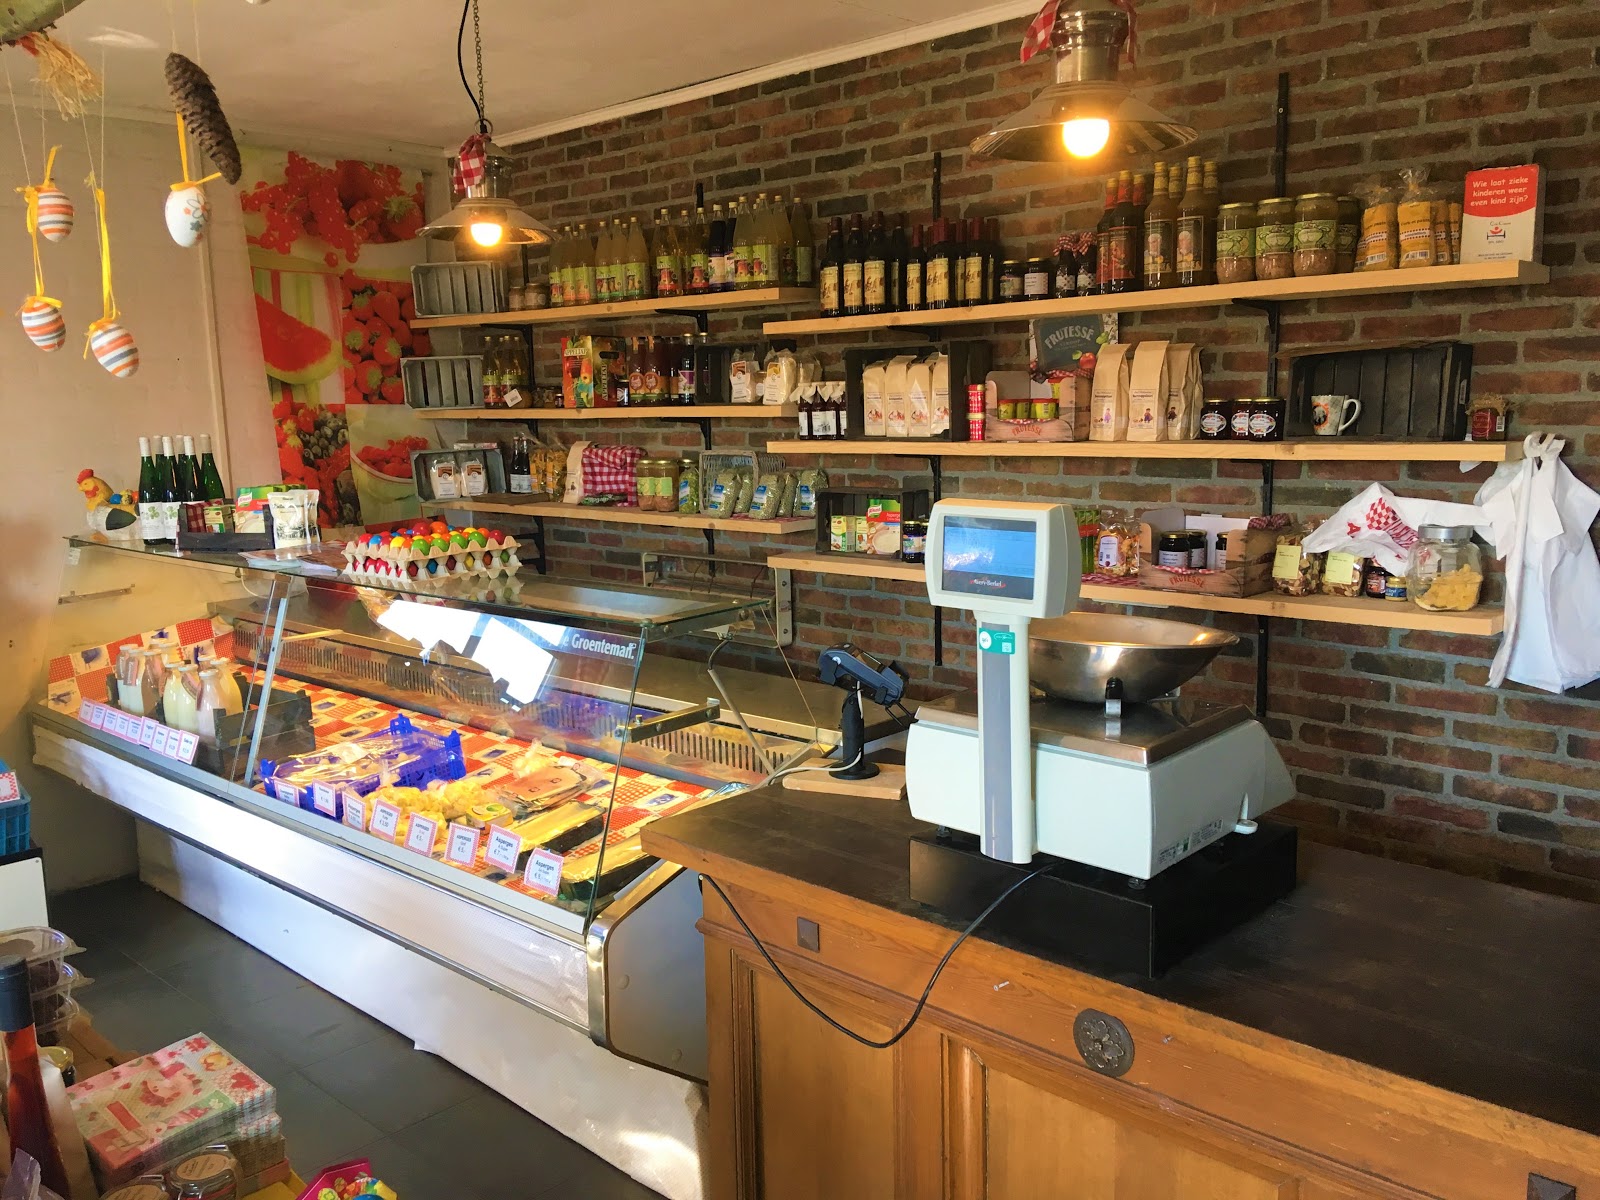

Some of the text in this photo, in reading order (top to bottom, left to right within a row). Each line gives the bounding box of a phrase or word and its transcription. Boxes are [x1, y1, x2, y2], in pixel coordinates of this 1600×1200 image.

[1490, 178, 1506, 187] laat
[1508, 176, 1529, 185] zieke
[1472, 188, 1506, 197] kinderen
[1470, 195, 1529, 207] even kind zijn?
[1044, 325, 1095, 349] FRUTESSE
[1012, 424, 1042, 436] FRUTESSE
[1169, 575, 1206, 588] FRUTESSE
[495, 836, 514, 848] Asperges
[535, 860, 555, 871] Asperges
